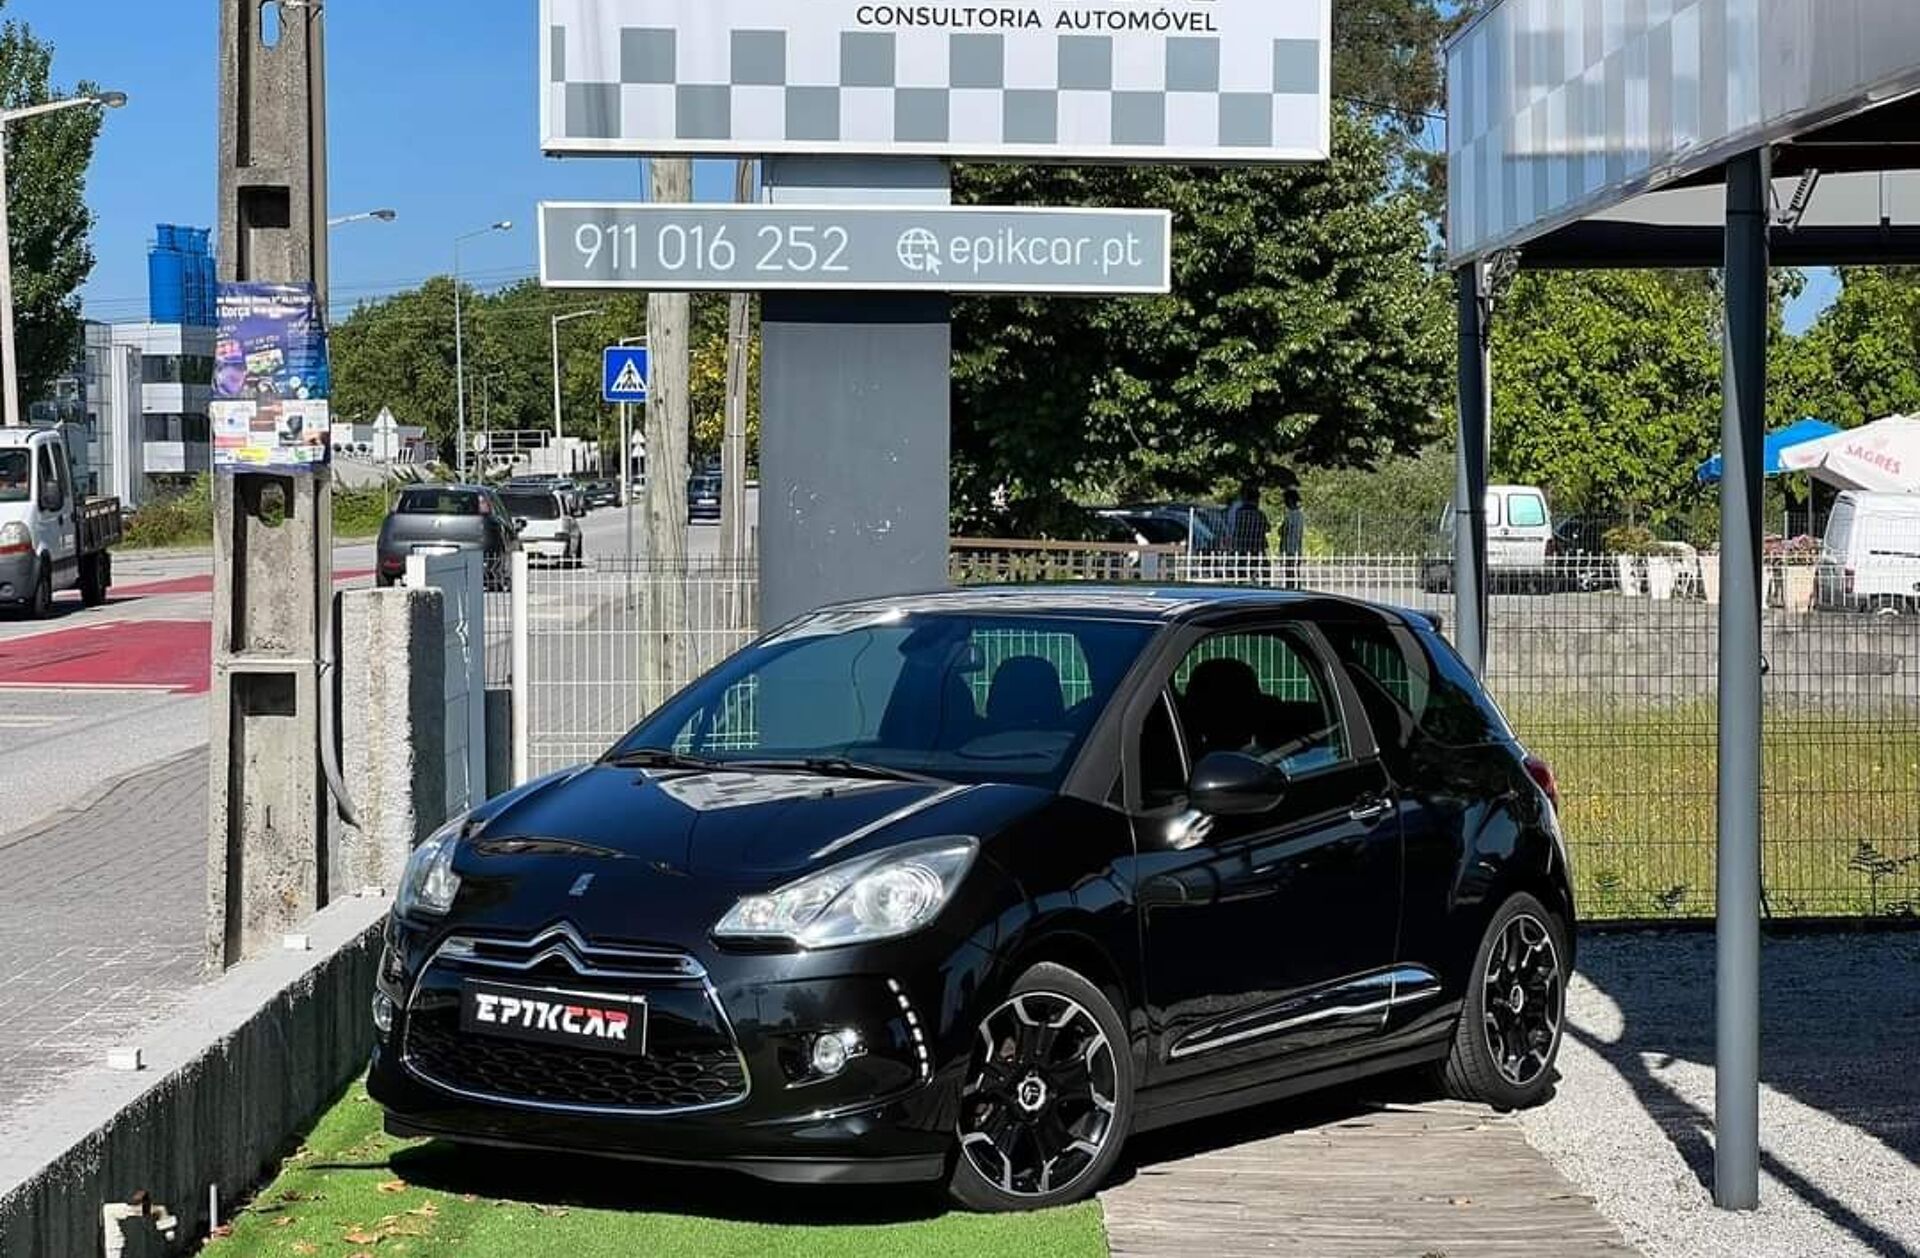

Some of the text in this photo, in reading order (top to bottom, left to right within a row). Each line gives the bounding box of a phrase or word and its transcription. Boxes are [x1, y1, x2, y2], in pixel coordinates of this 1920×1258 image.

[856, 6, 1218, 31] CONSULTORIA AUTOMÓVEL
[575, 223, 1142, 275] 911 016 252 epikcar.pt
[476, 993, 628, 1040] EPIKCAR
